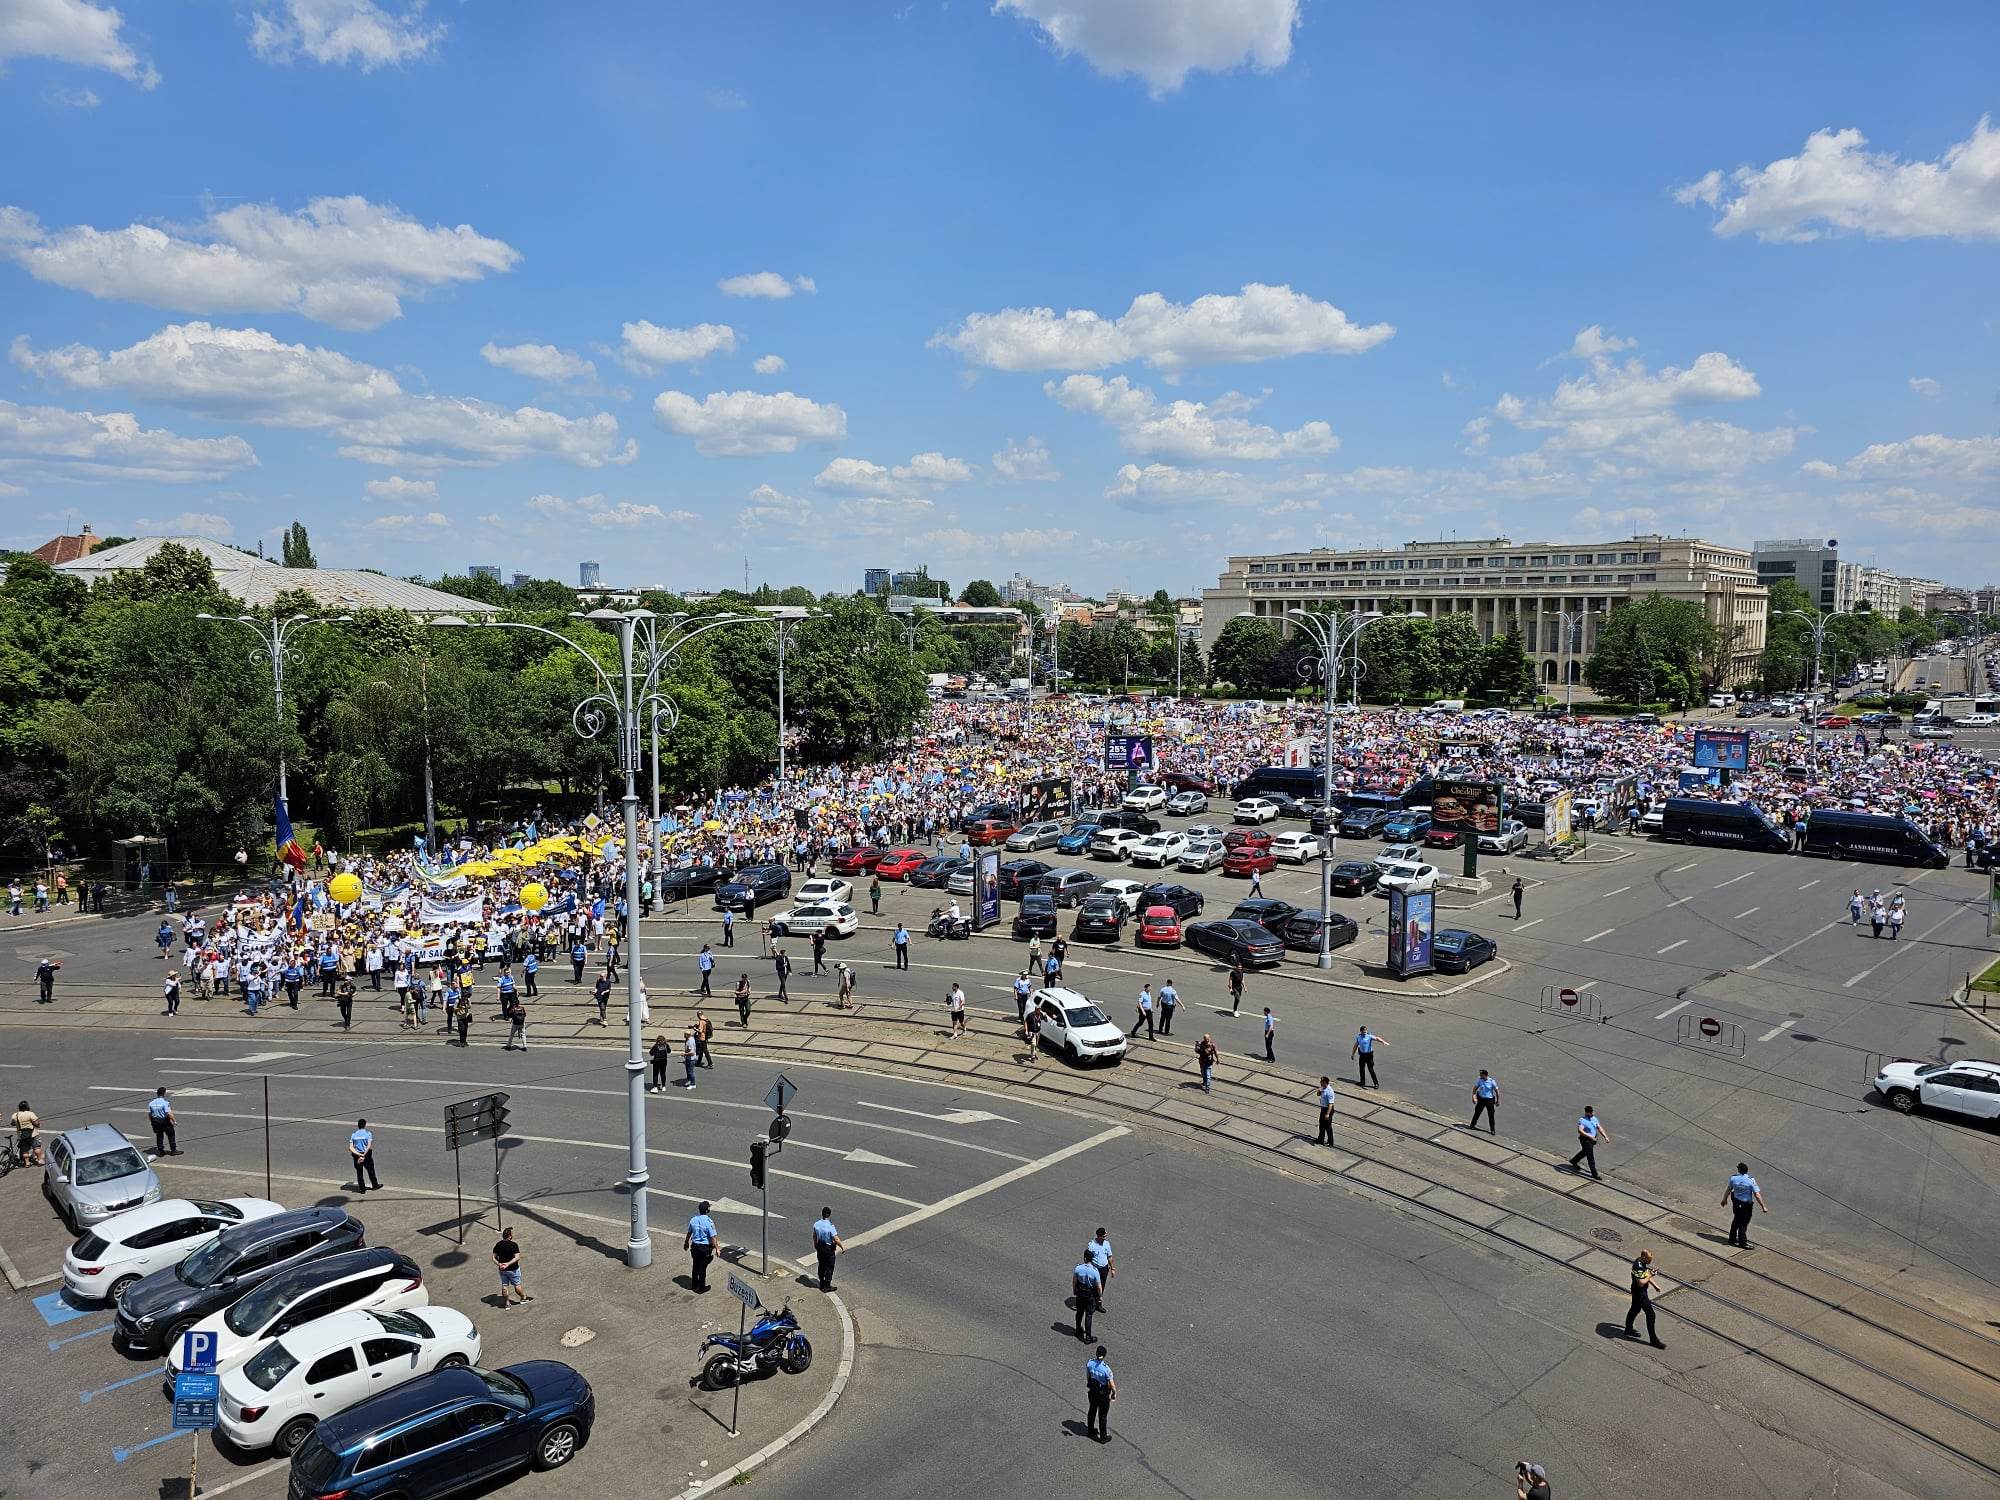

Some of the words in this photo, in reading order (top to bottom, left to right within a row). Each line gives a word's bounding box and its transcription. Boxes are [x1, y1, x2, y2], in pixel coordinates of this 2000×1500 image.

[1109, 745, 1127, 753] 25%
[1699, 829, 1744, 839] JANDARMERIA
[1848, 843, 1898, 854] JANDARMERIA
[191, 1333, 210, 1367] P
